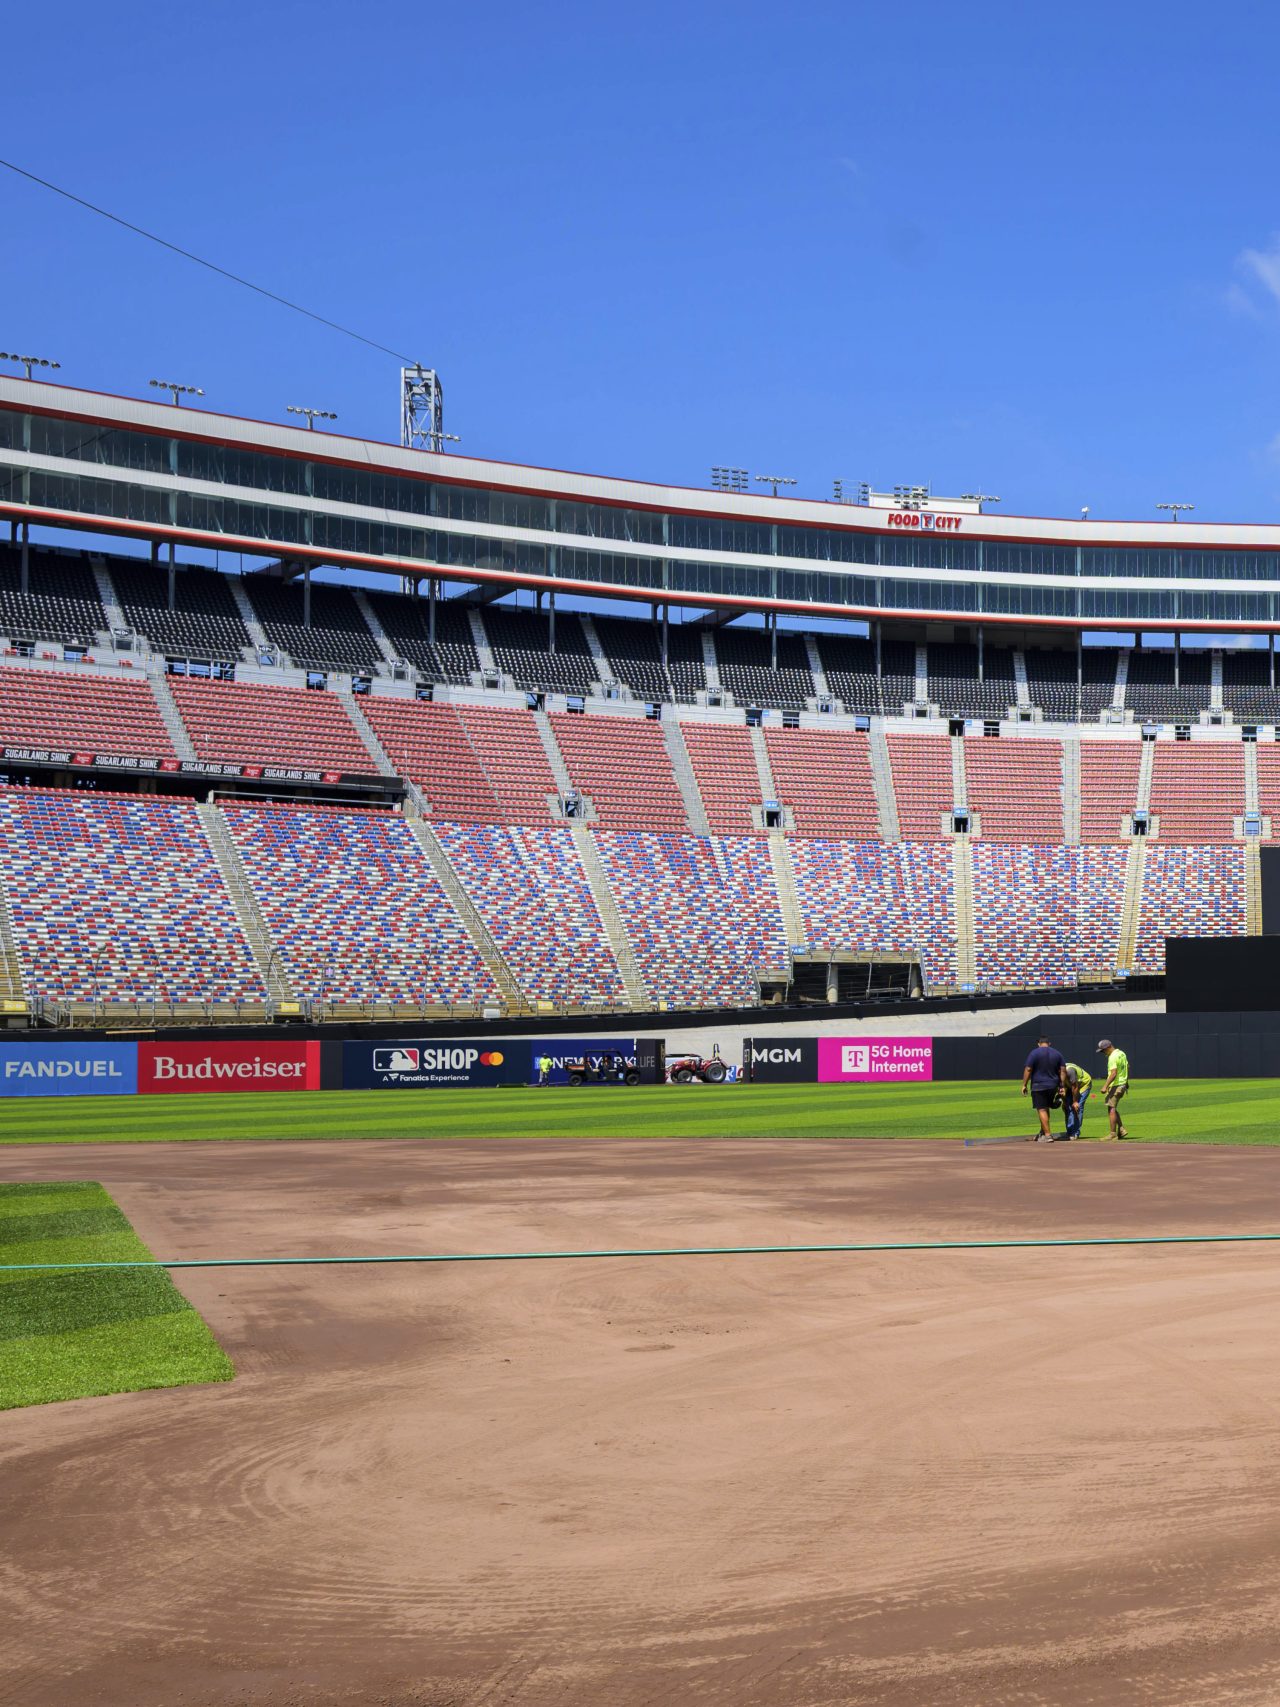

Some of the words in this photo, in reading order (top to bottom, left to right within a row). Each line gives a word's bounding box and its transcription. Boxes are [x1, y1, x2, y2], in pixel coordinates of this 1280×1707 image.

[888, 514, 919, 526] FOOD
[936, 517, 961, 528] CITY
[5, 750, 49, 760] SUGARLANDS
[50, 754, 71, 762] SHINE
[95, 757, 138, 767] SUGARLANDS
[182, 762, 222, 773] SUGARLANDS
[223, 767, 241, 775] SHINE
[264, 769, 302, 780] SUGARLANDS
[303, 773, 321, 781] SHINE
[752, 1048, 802, 1063] MGM
[871, 1045, 890, 1058] 5G
[893, 1046, 931, 1057] Home
[423, 1048, 479, 1070] SHOP
[552, 1056, 586, 1069] NEW
[591, 1056, 636, 1069] YRK
[5, 1060, 122, 1078] FANDUEL
[153, 1056, 306, 1079] Budweiser
[871, 1061, 924, 1072] Internet
[430, 1074, 470, 1082] Experience
